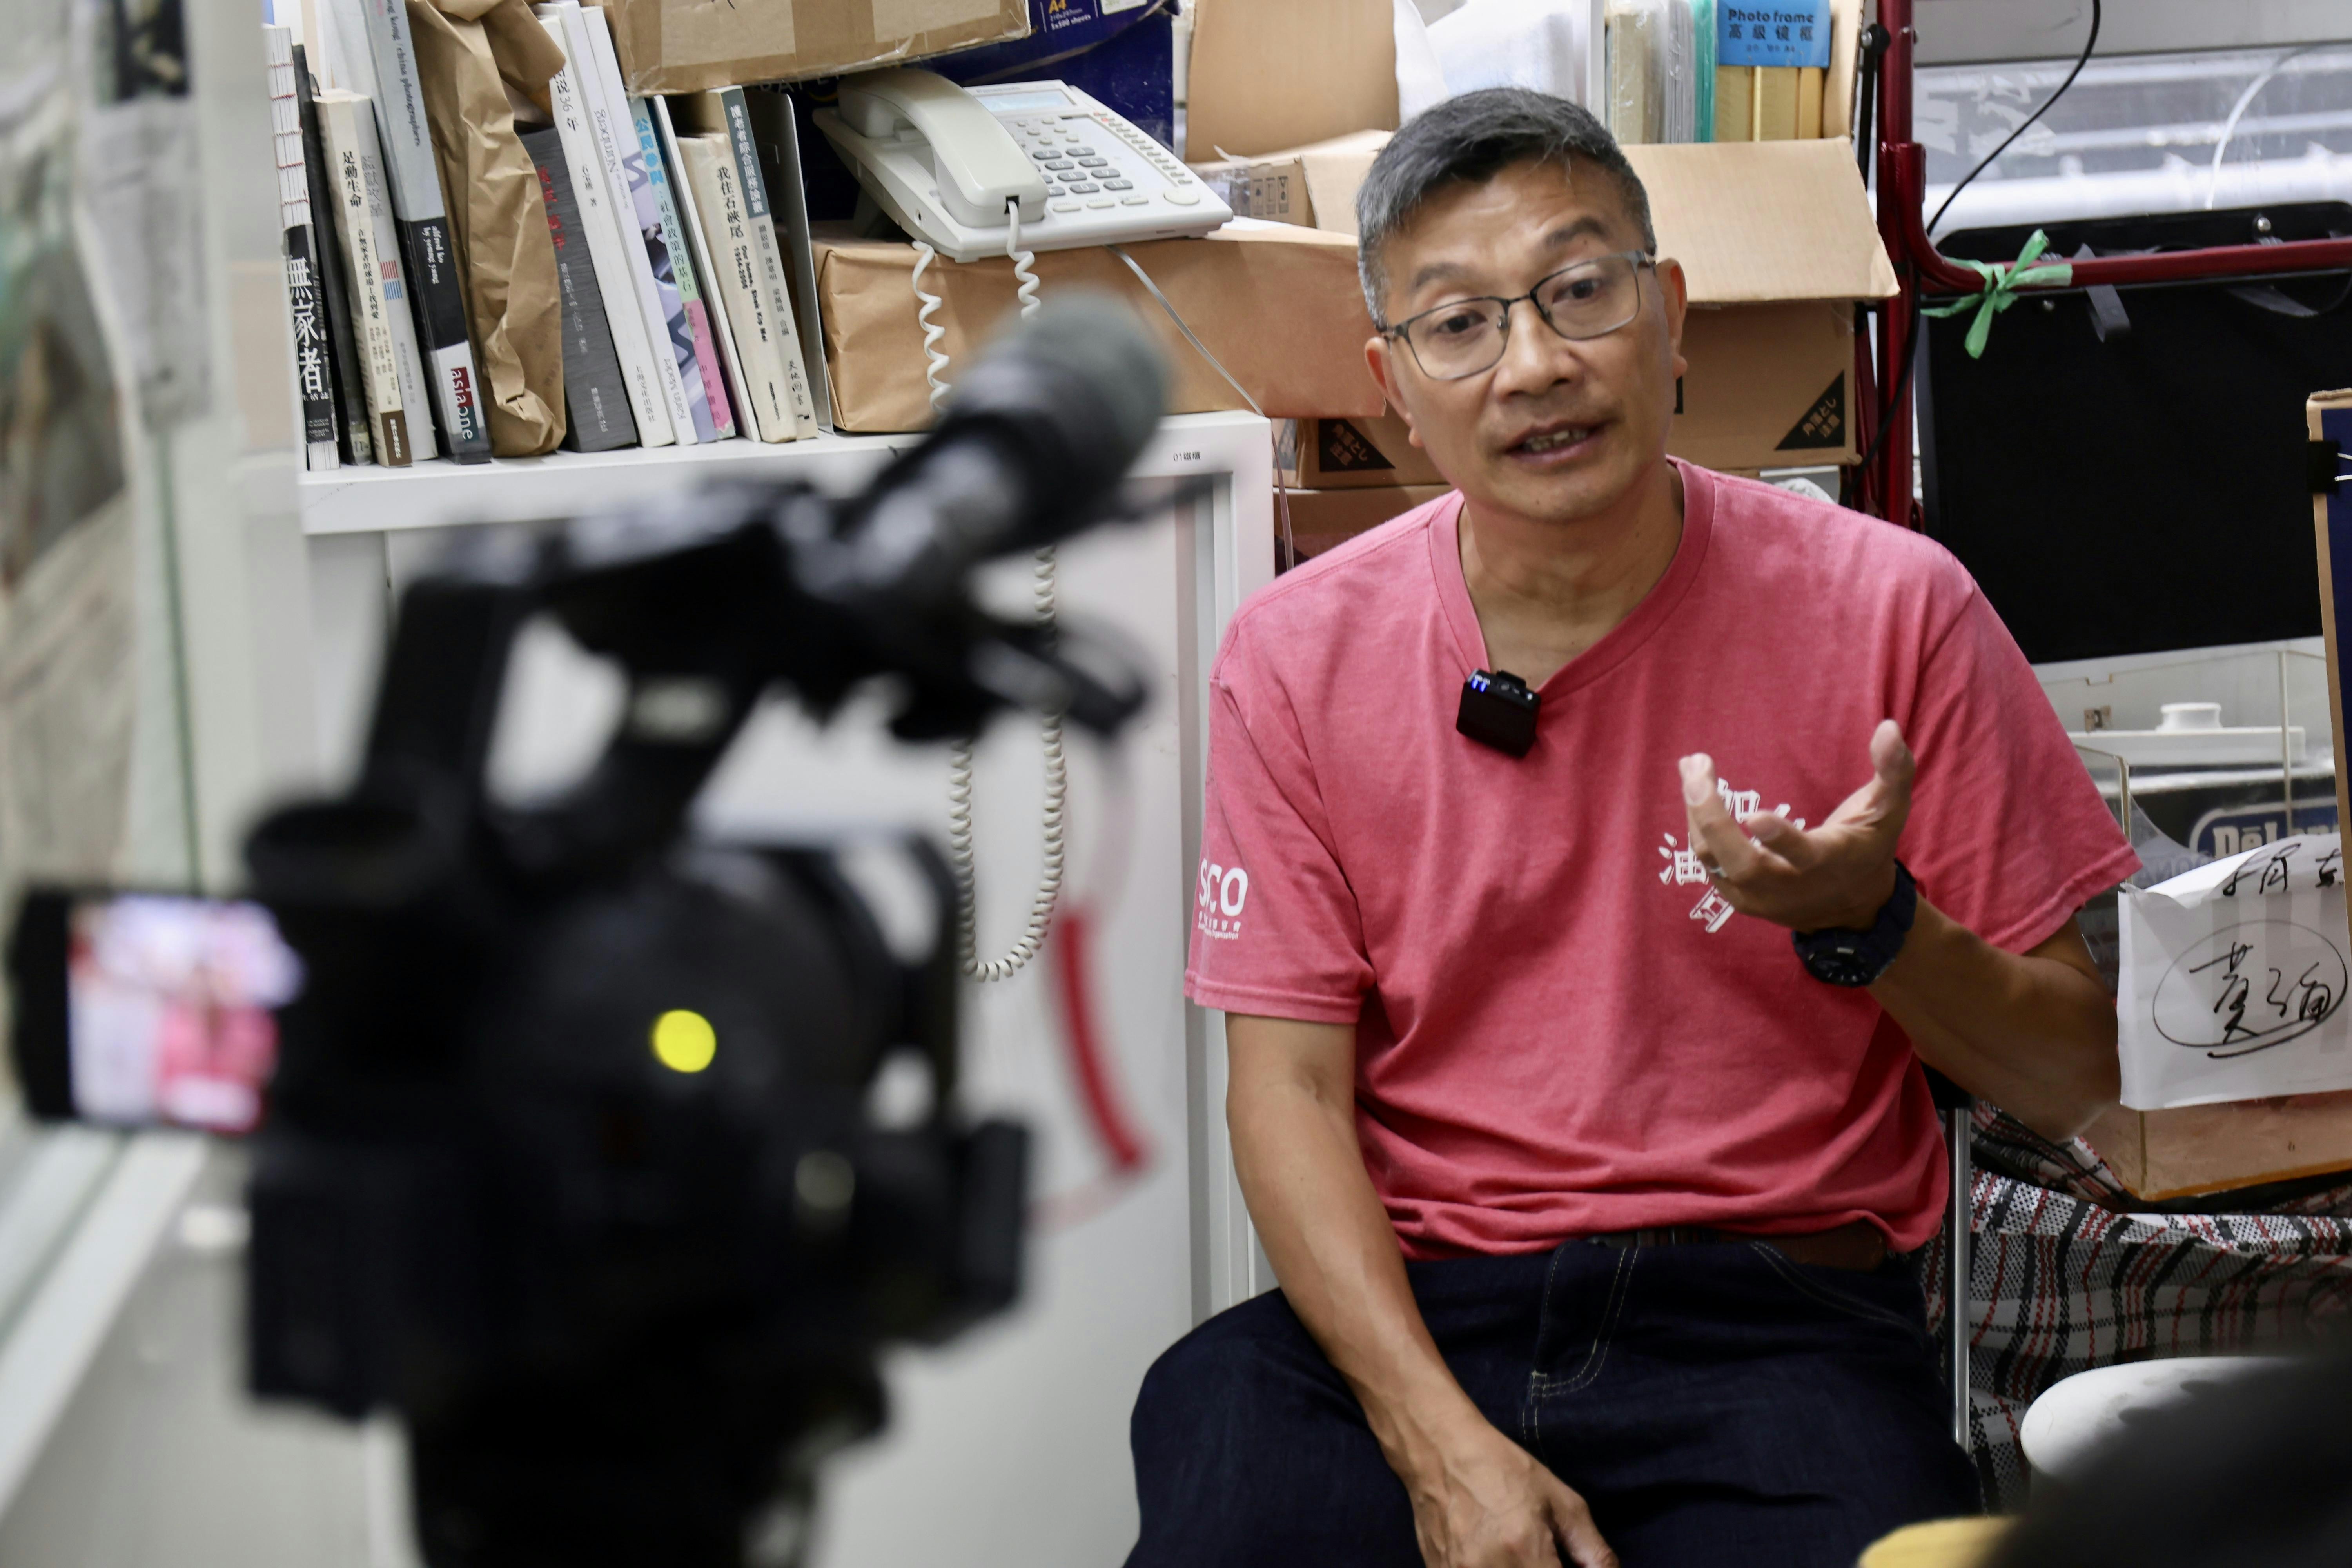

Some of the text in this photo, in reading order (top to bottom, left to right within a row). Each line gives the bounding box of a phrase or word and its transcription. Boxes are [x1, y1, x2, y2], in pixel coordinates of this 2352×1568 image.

[1728, 9, 1814, 23] Photo frame
[289, 256, 323, 394] 無家者
